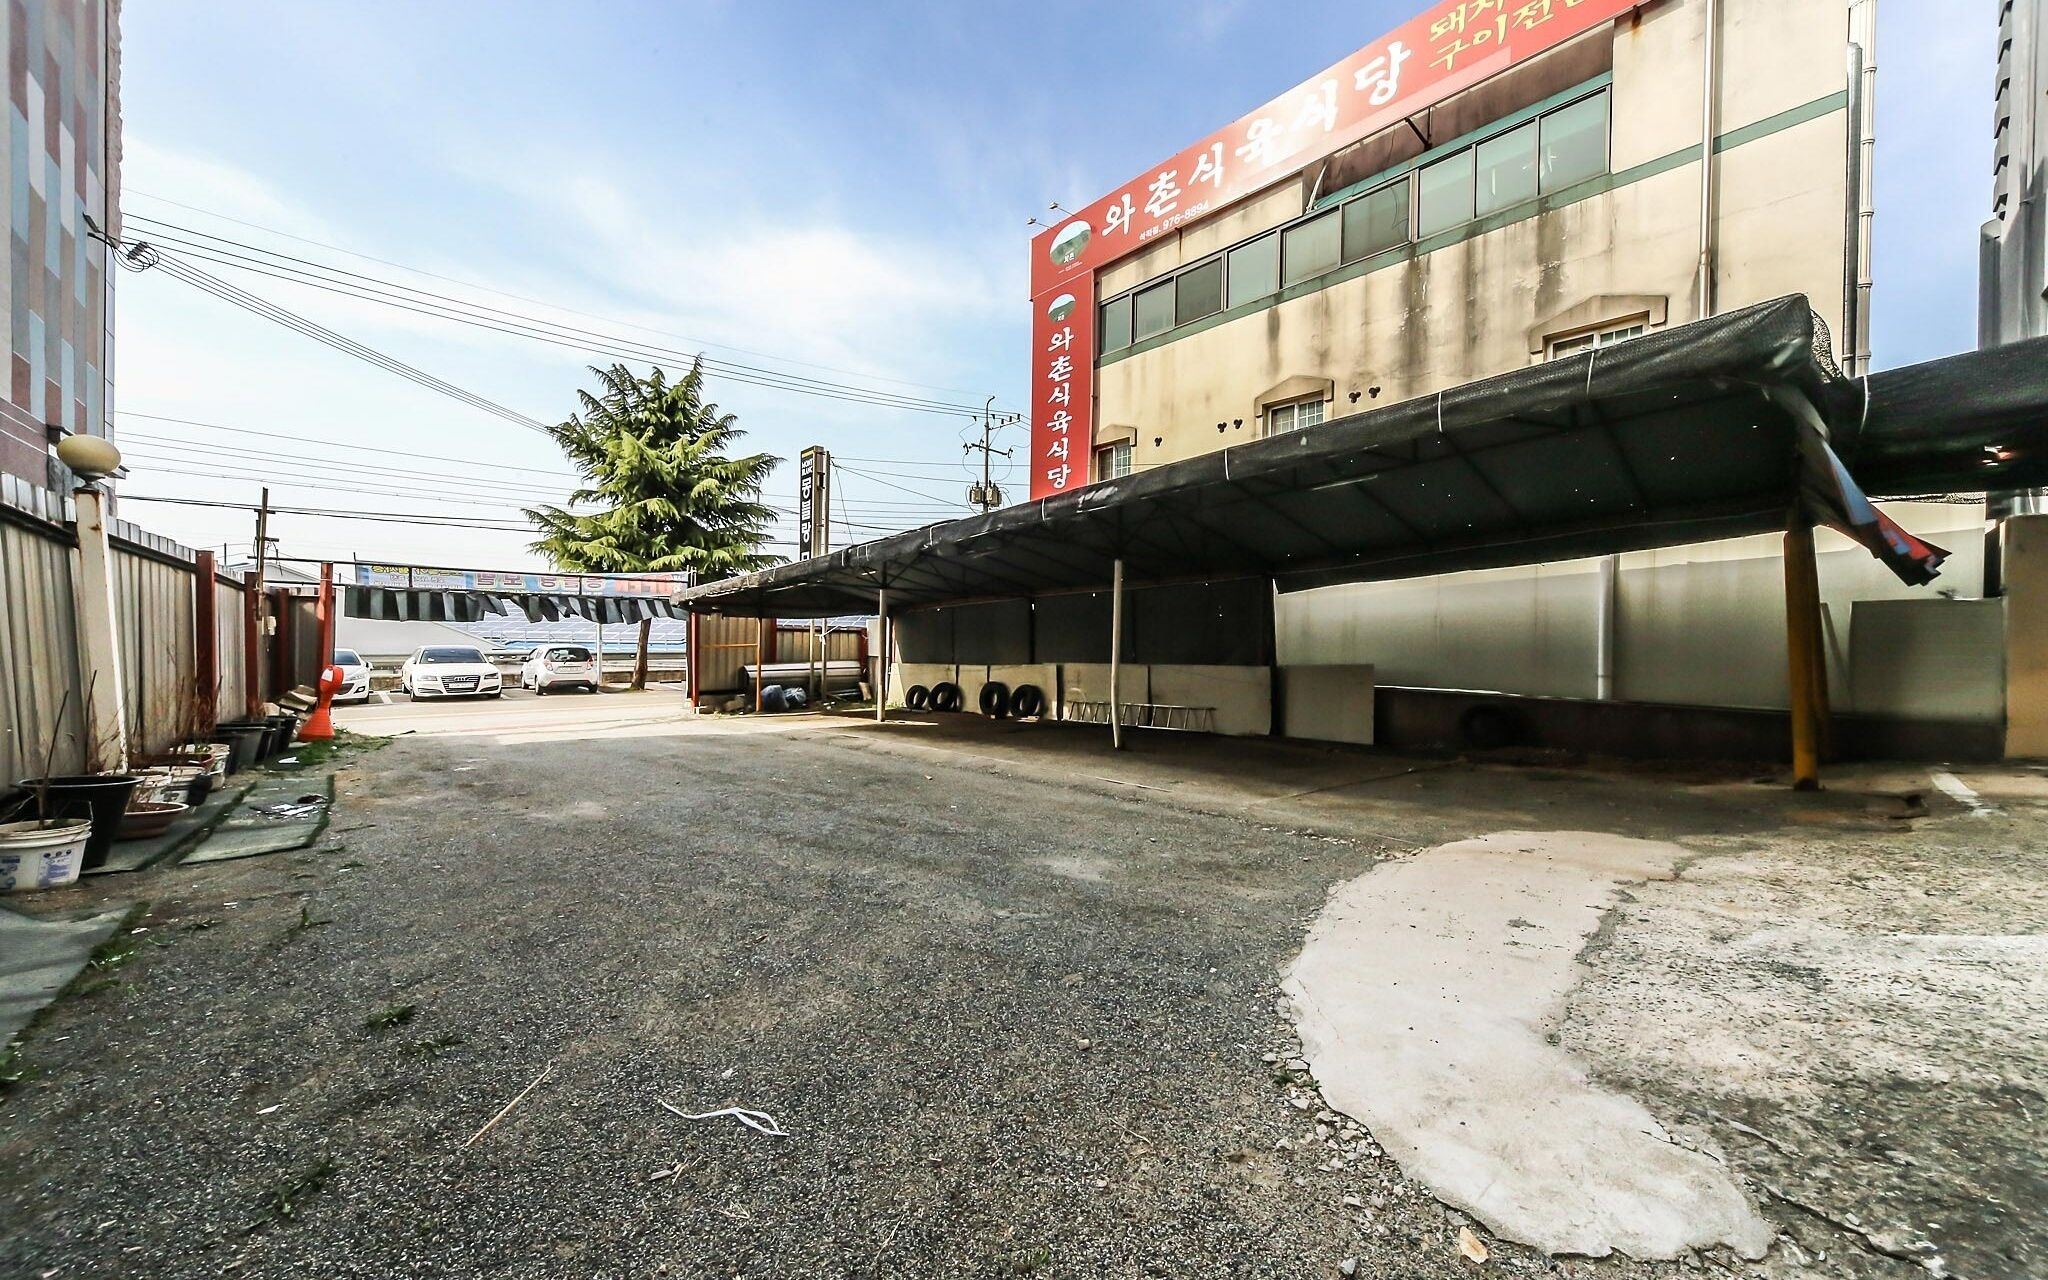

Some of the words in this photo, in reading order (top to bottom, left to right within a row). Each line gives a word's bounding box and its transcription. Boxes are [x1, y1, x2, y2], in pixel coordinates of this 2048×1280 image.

[1102, 41, 1411, 237] 와촌식육식당
[1162, 200, 1209, 231] 976-8894
[1047, 326, 1075, 489] 와촌식육식당
